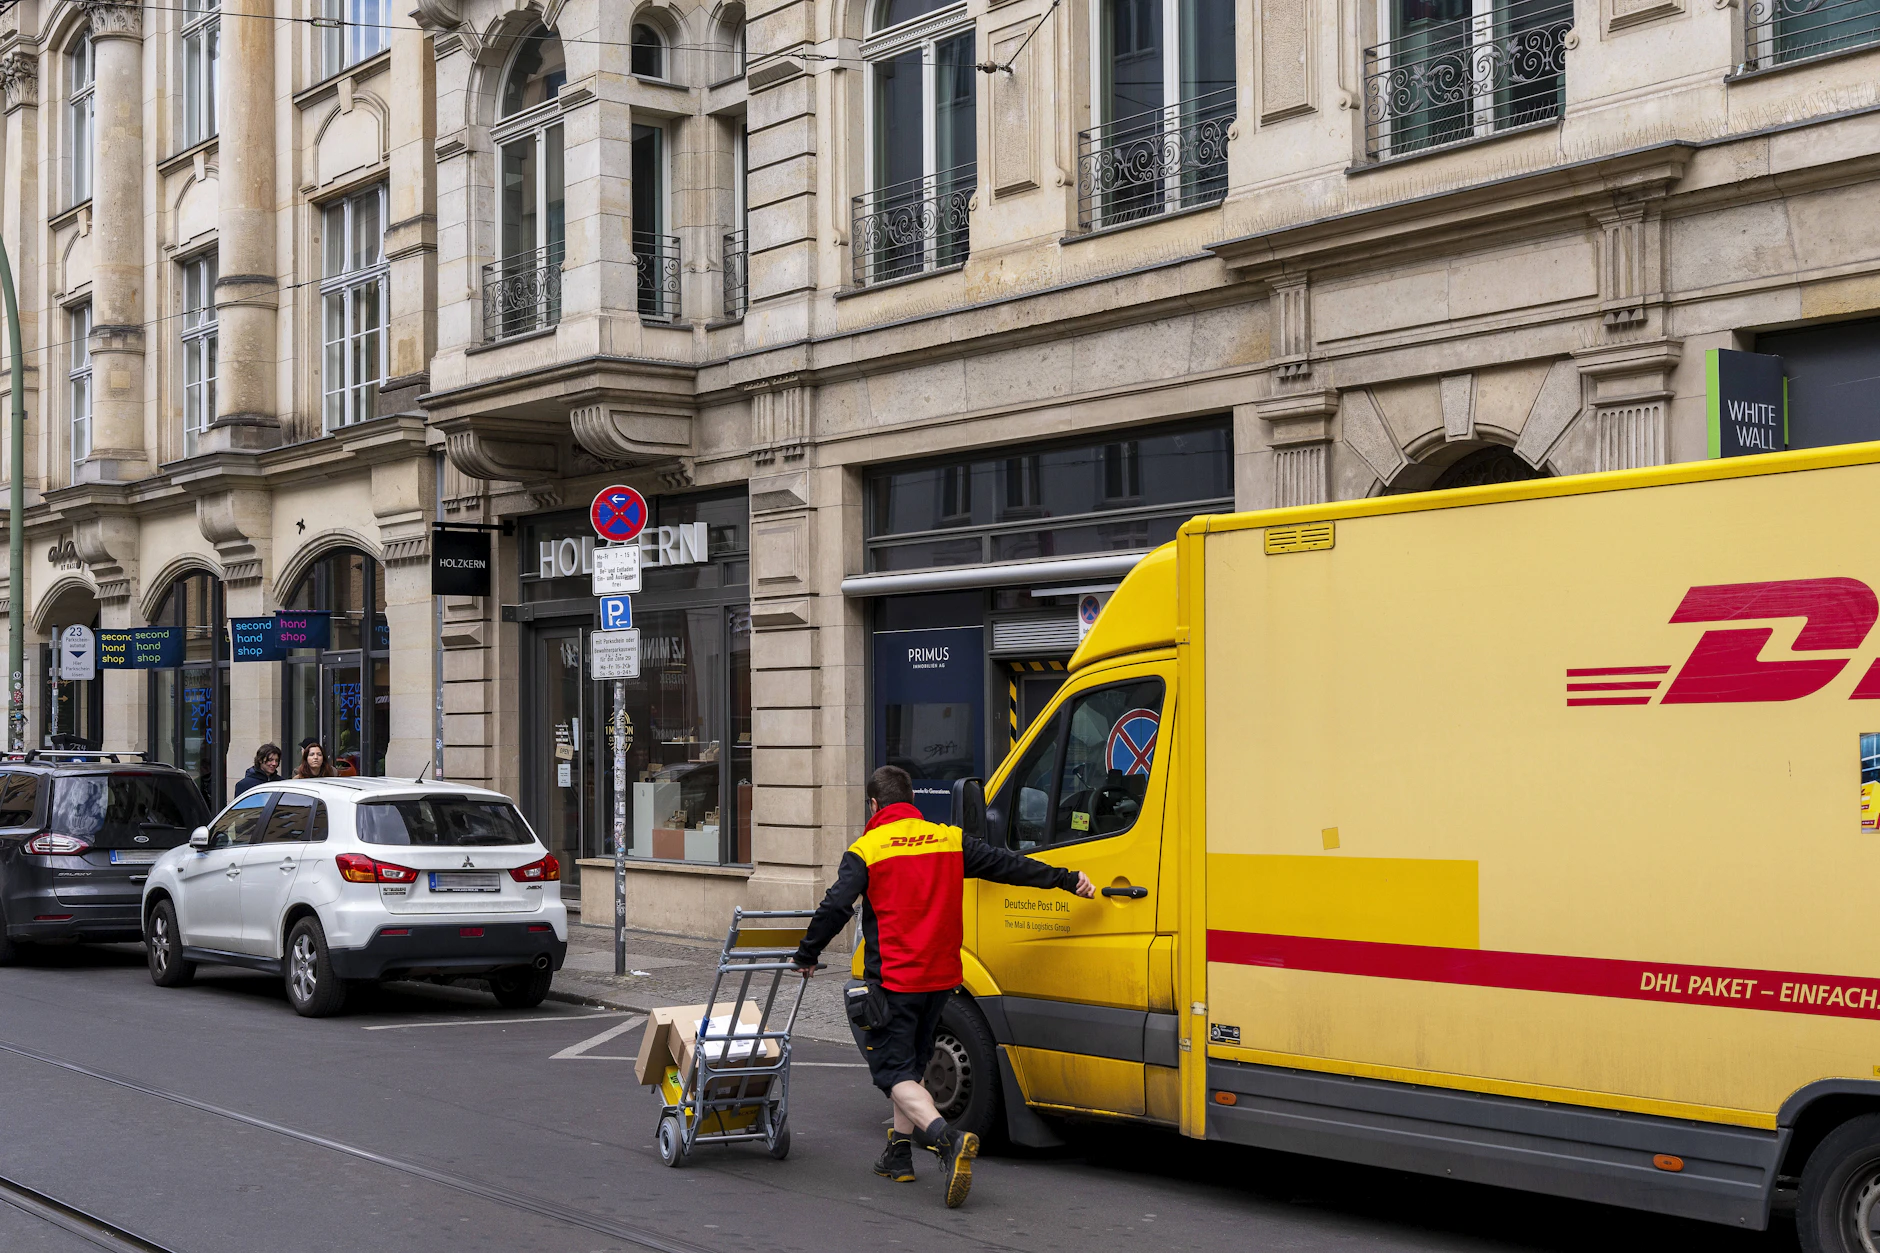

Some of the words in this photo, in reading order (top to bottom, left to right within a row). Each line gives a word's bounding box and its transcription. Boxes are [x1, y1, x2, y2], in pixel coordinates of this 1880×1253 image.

[1727, 399, 1777, 426] WHITE
[1736, 424, 1777, 450] WALL
[540, 522, 708, 579] HOLERN
[439, 557, 486, 569] HOLZKERN
[607, 600, 624, 626] P
[236, 620, 272, 631] second
[280, 618, 307, 629] hand
[69, 626, 83, 637] 23
[135, 629, 170, 640] second
[237, 633, 263, 643] hand
[280, 632, 307, 643] shop
[603, 637, 625, 645] Parkschein
[101, 643, 126, 652] hand
[136, 642, 161, 651] hand
[237, 645, 263, 657] shop
[101, 654, 125, 664] shop
[137, 653, 161, 664] shop
[908, 646, 950, 662] PRIMUS
[559, 747, 570, 756] OPEN
[890, 834, 939, 847] DHL
[1004, 898, 1036, 910] Deutsche
[1037, 900, 1053, 911] Post
[1055, 901, 1070, 912] DHL
[1004, 919, 1013, 929] The
[1014, 920, 1025, 929] Mail
[1031, 921, 1053, 932] Logistics
[1054, 923, 1070, 933] Group
[1640, 971, 1682, 993] DHL
[1687, 975, 1757, 998] PAKET
